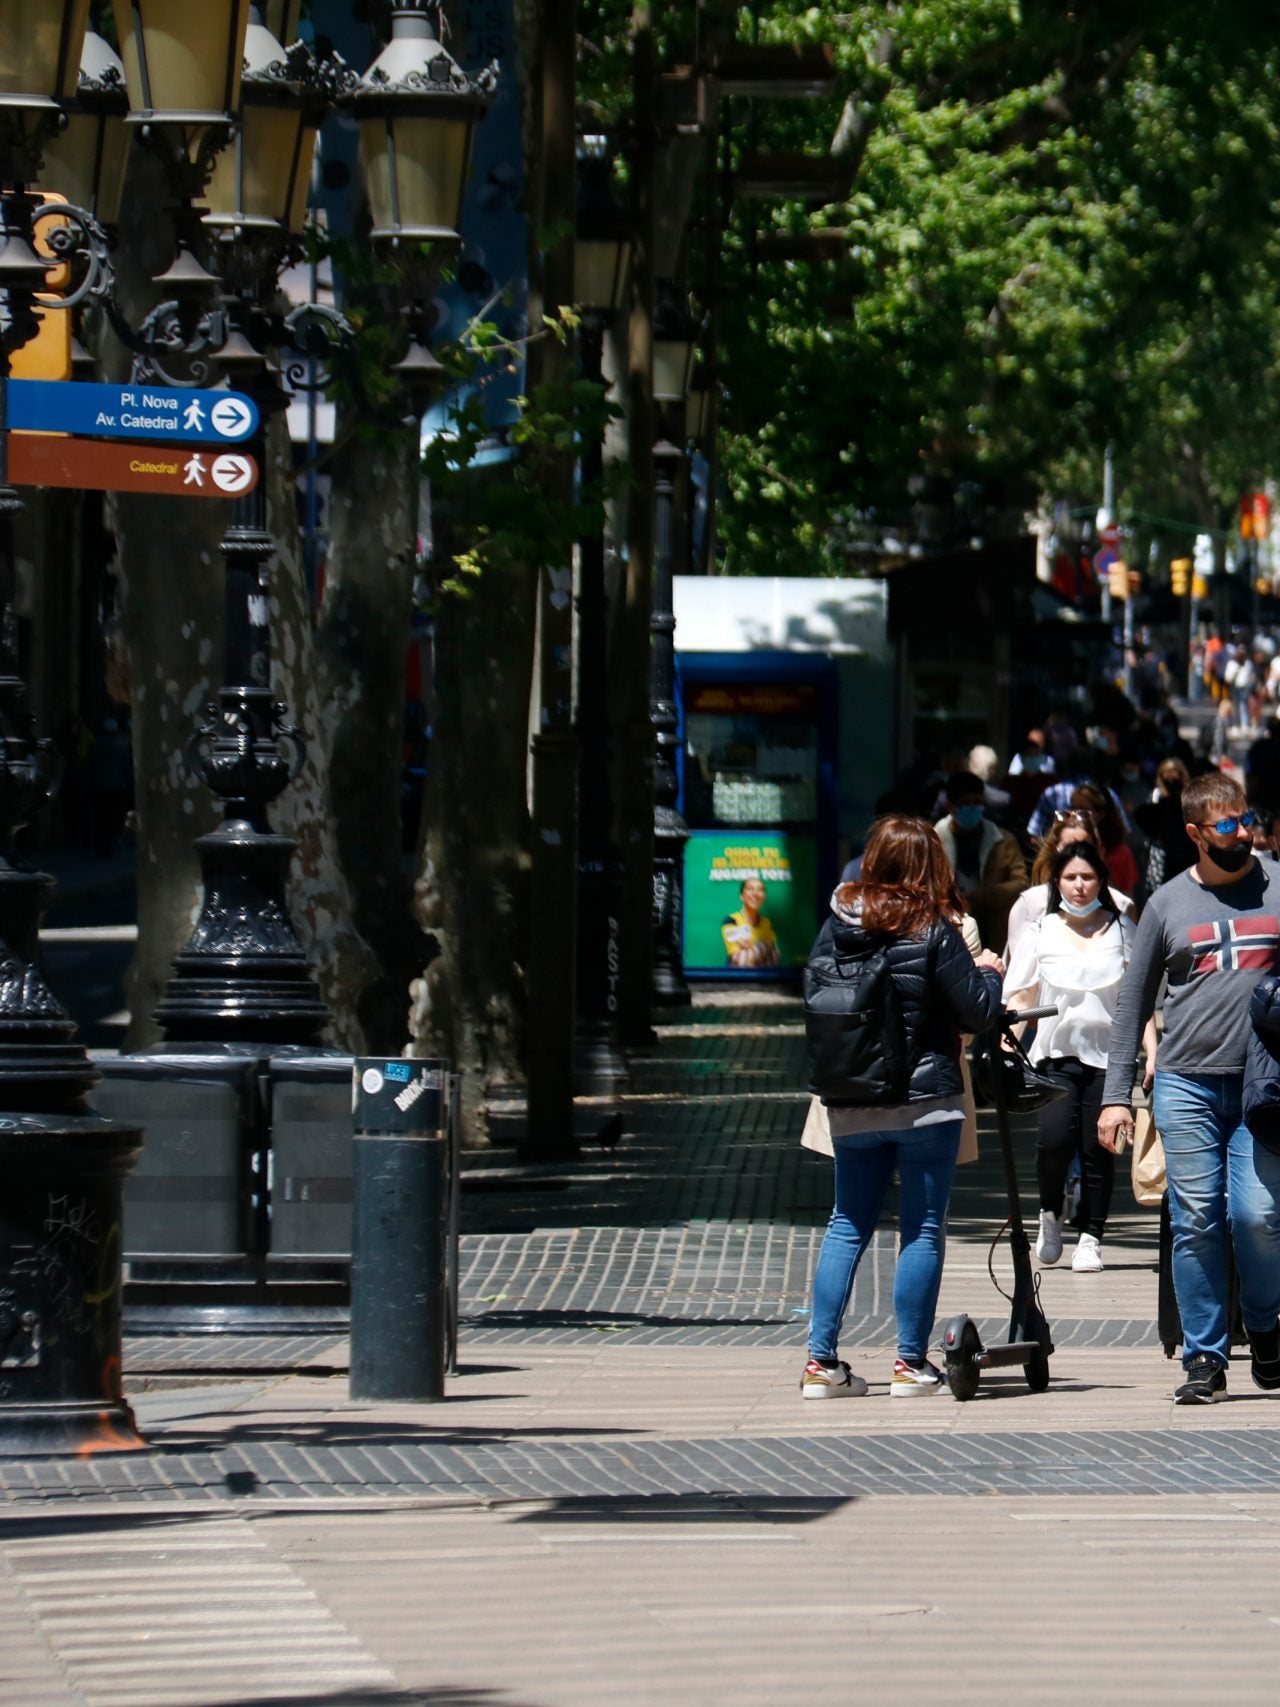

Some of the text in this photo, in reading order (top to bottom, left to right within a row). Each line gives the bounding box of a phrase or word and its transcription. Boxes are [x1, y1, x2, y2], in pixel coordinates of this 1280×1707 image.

[121, 393, 178, 410] Pl. Nova
[96, 413, 178, 430] Av. Catedral
[129, 460, 179, 475] Catedral
